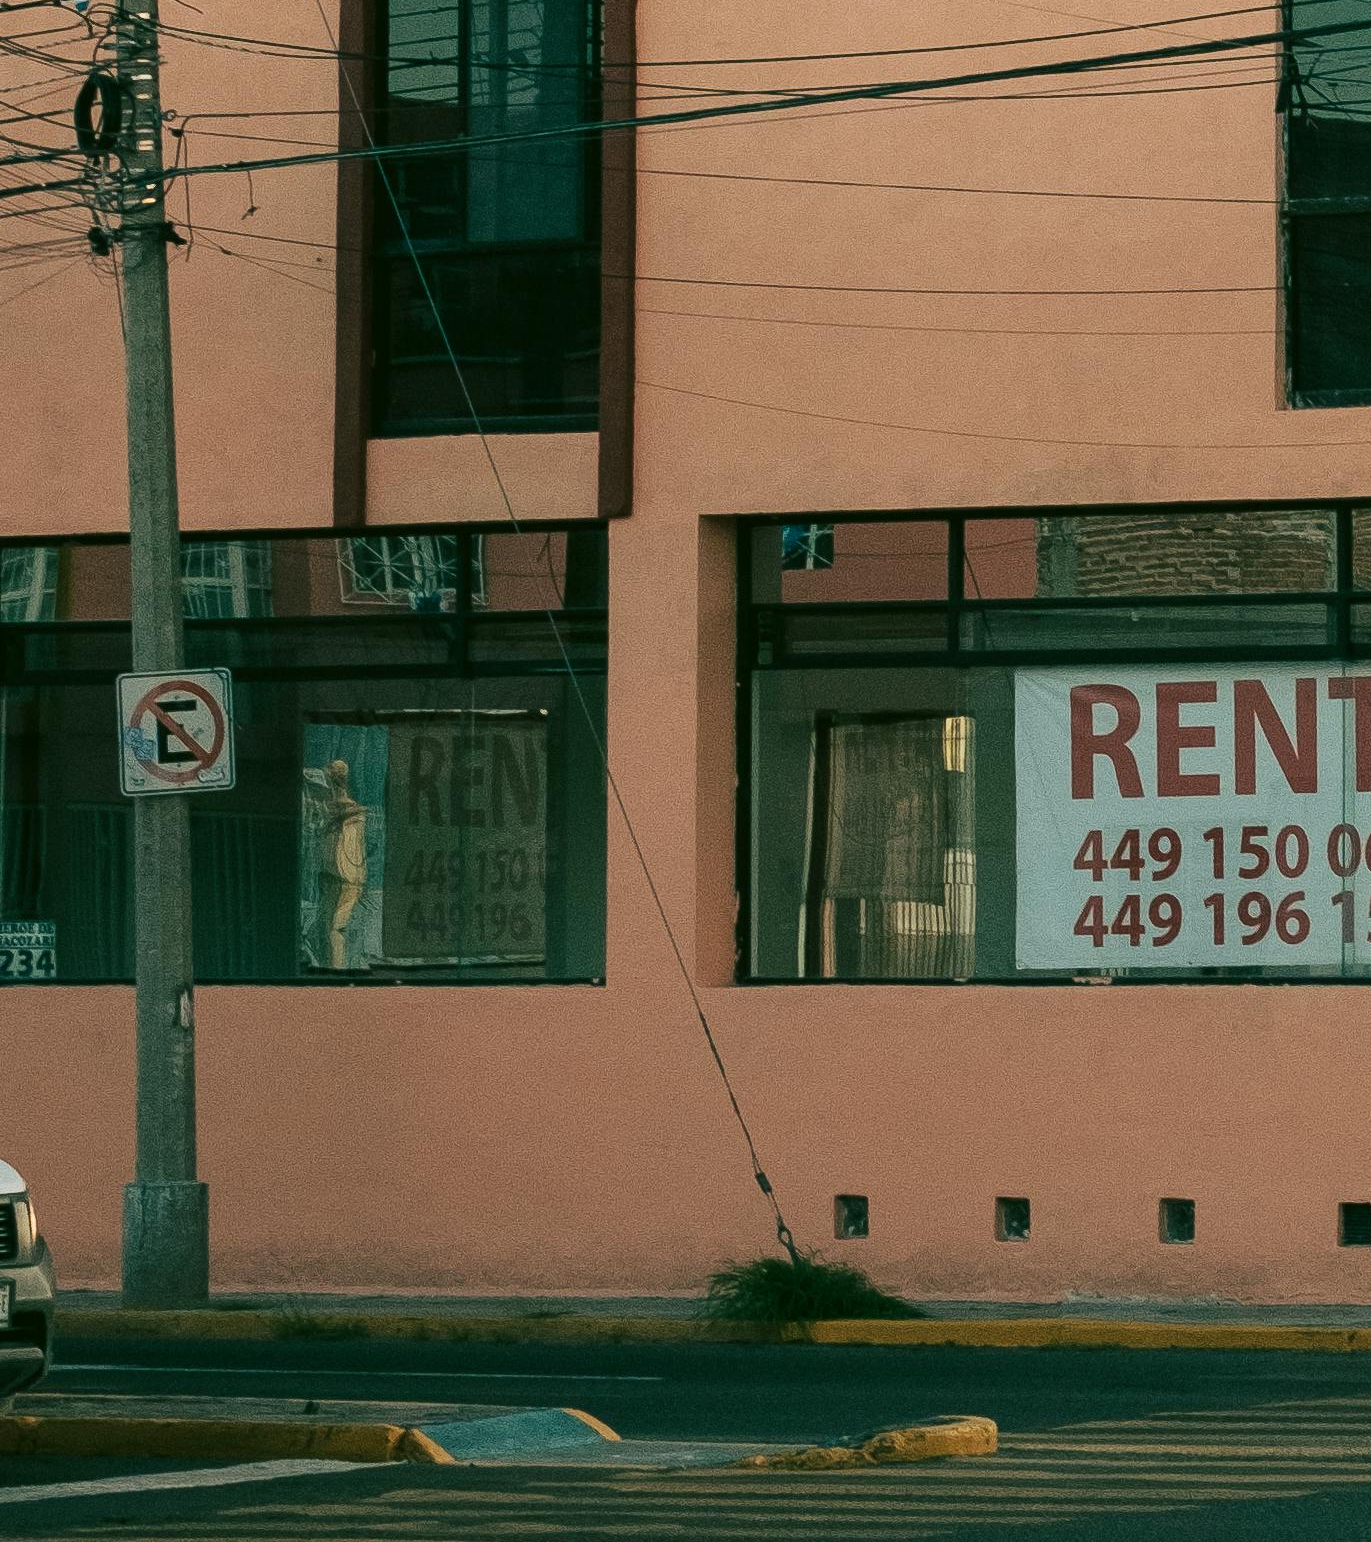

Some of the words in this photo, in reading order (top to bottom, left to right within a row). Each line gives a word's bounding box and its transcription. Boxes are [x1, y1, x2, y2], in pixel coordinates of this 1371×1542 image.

[409, 735, 546, 828] REN
[404, 850, 465, 893] 449
[1073, 828, 1183, 882] 449
[1203, 825, 1310, 881] 150
[0, 923, 35, 933] EROE
[406, 900, 465, 942] 449
[474, 902, 533, 942] 196
[1073, 893, 1183, 947] 449
[1203, 891, 1311, 945] 196
[0, 935, 55, 947] ACOZARI
[0, 949, 55, 978] 234
